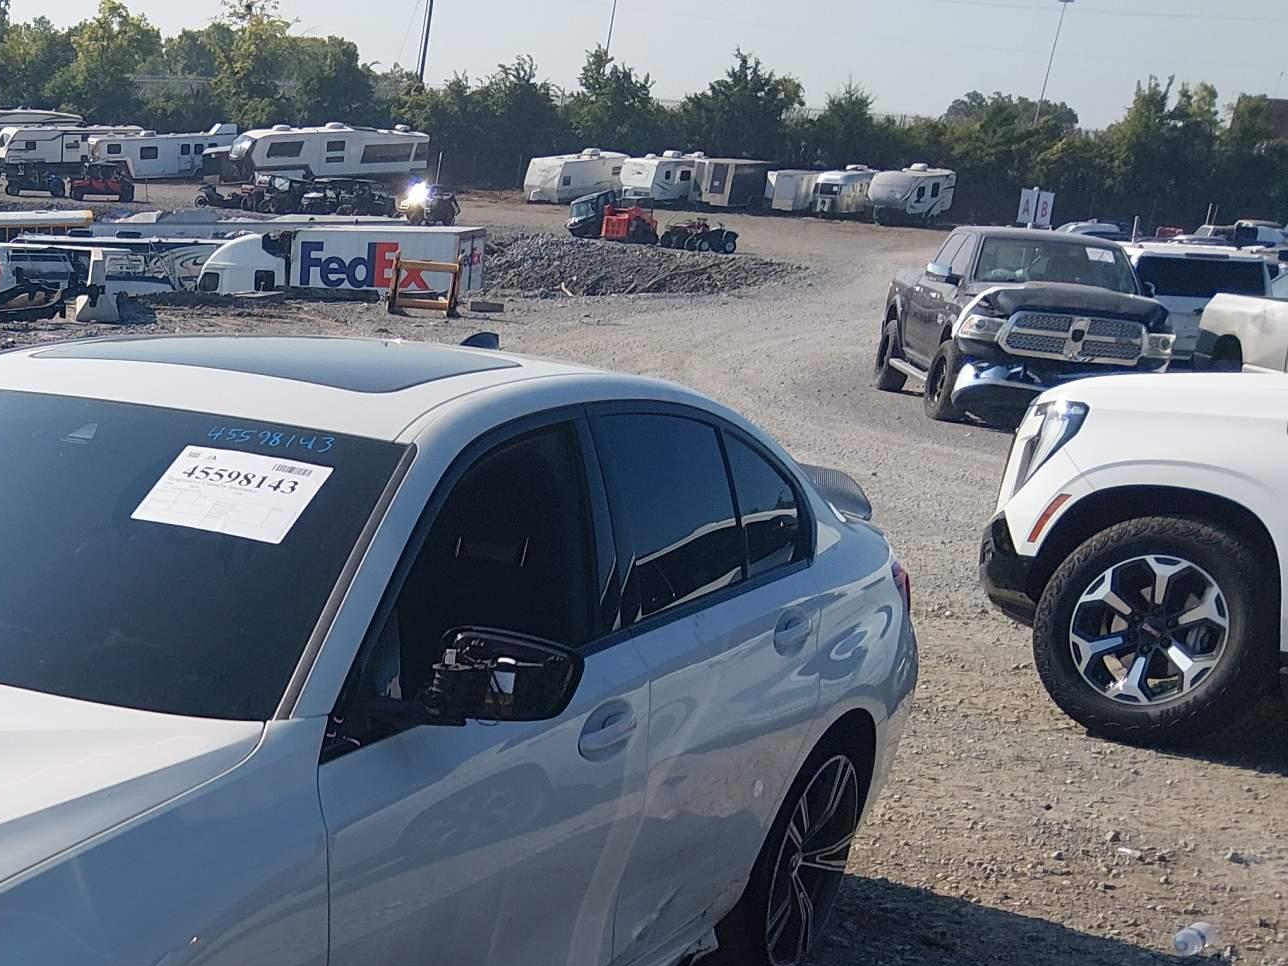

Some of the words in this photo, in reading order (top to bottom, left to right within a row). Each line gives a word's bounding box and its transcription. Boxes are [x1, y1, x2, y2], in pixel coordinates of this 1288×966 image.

[1022, 198, 1031, 216] A
[1040, 200, 1049, 218] B
[300, 241, 430, 290] FedEx
[208, 426, 335, 453] 45598143
[182, 464, 299, 495] 45598143
